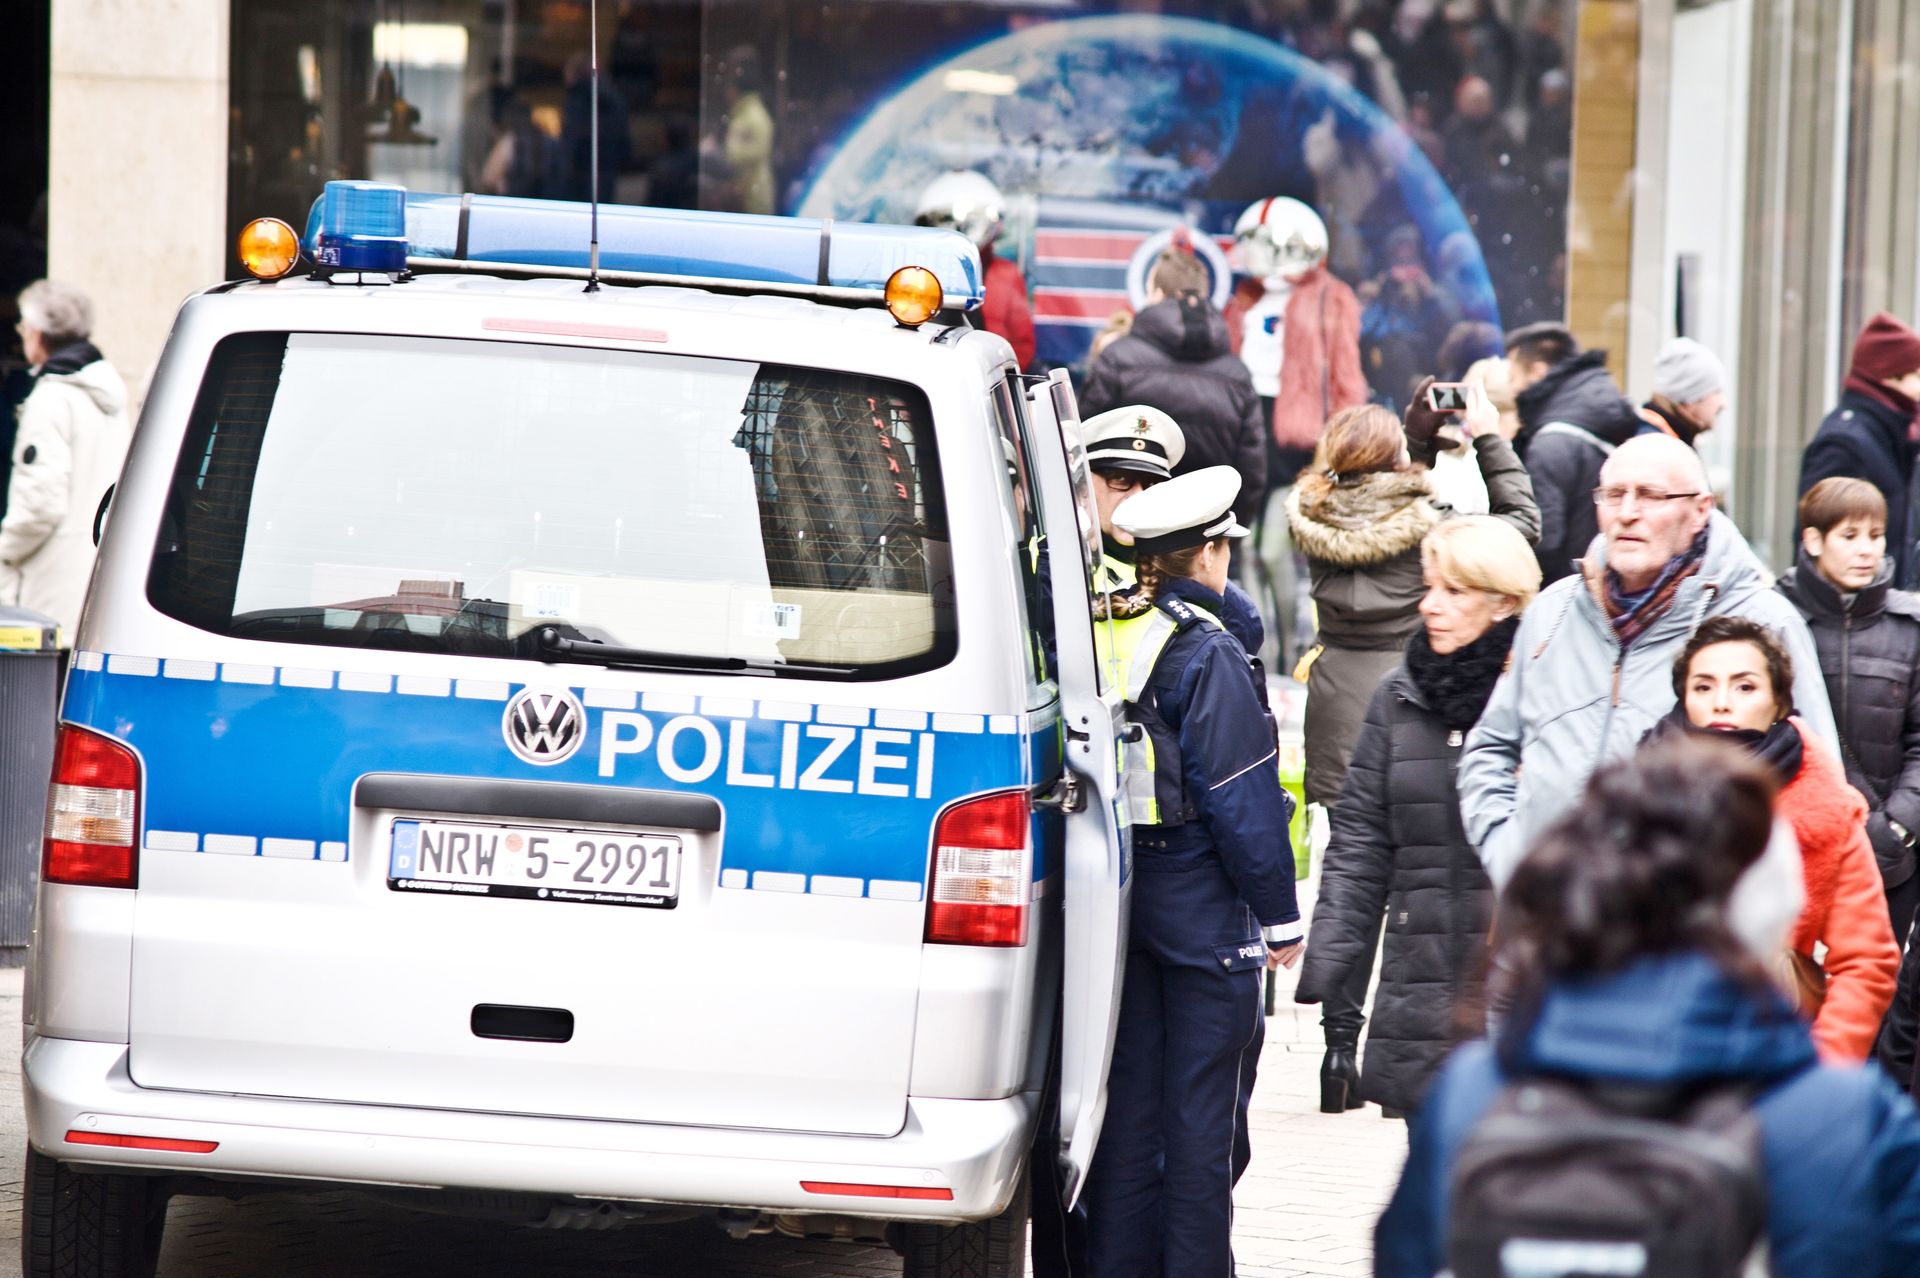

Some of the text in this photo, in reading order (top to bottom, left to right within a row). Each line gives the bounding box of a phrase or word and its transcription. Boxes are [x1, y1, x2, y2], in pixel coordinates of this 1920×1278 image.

[511, 691, 577, 757] VW
[598, 710, 935, 799] POLIZEI
[398, 855, 409, 869] D
[419, 830, 671, 888] NRW 5-2991
